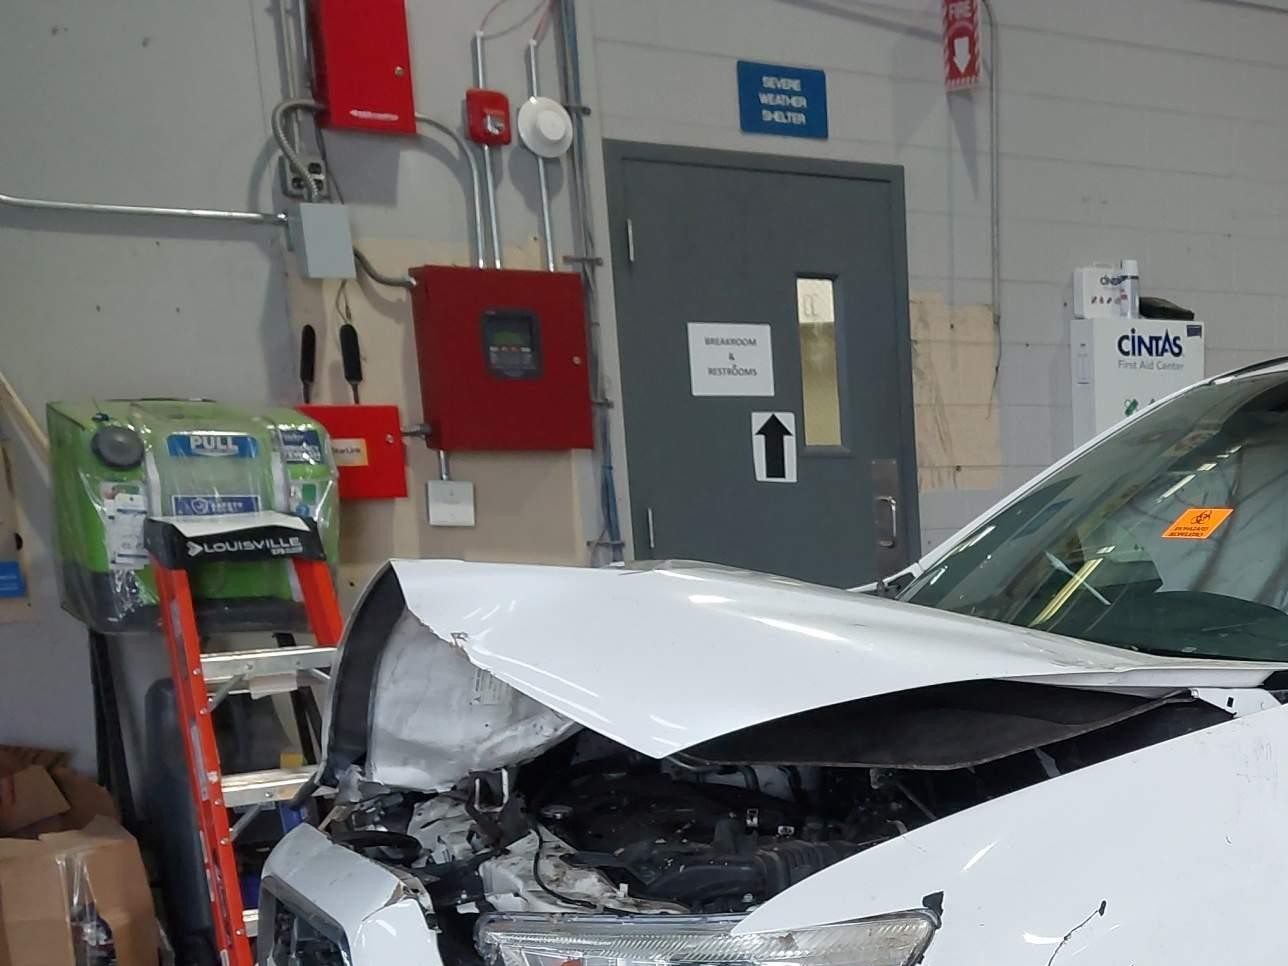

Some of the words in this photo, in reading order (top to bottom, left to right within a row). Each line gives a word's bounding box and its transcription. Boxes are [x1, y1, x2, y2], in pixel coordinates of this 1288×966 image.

[948, 1, 972, 17] FIRE
[762, 76, 801, 91] SEVERE
[758, 92, 807, 108] WEATHER
[762, 109, 806, 125] SHELTER
[704, 337, 757, 347] BREAKROOM
[707, 367, 758, 377] RESTROOMS
[1118, 360, 1137, 369] First
[1139, 360, 1154, 370] Aid
[1156, 361, 1185, 371] Center
[190, 435, 238, 450] PULL
[203, 536, 301, 553] LOUISVILLE
